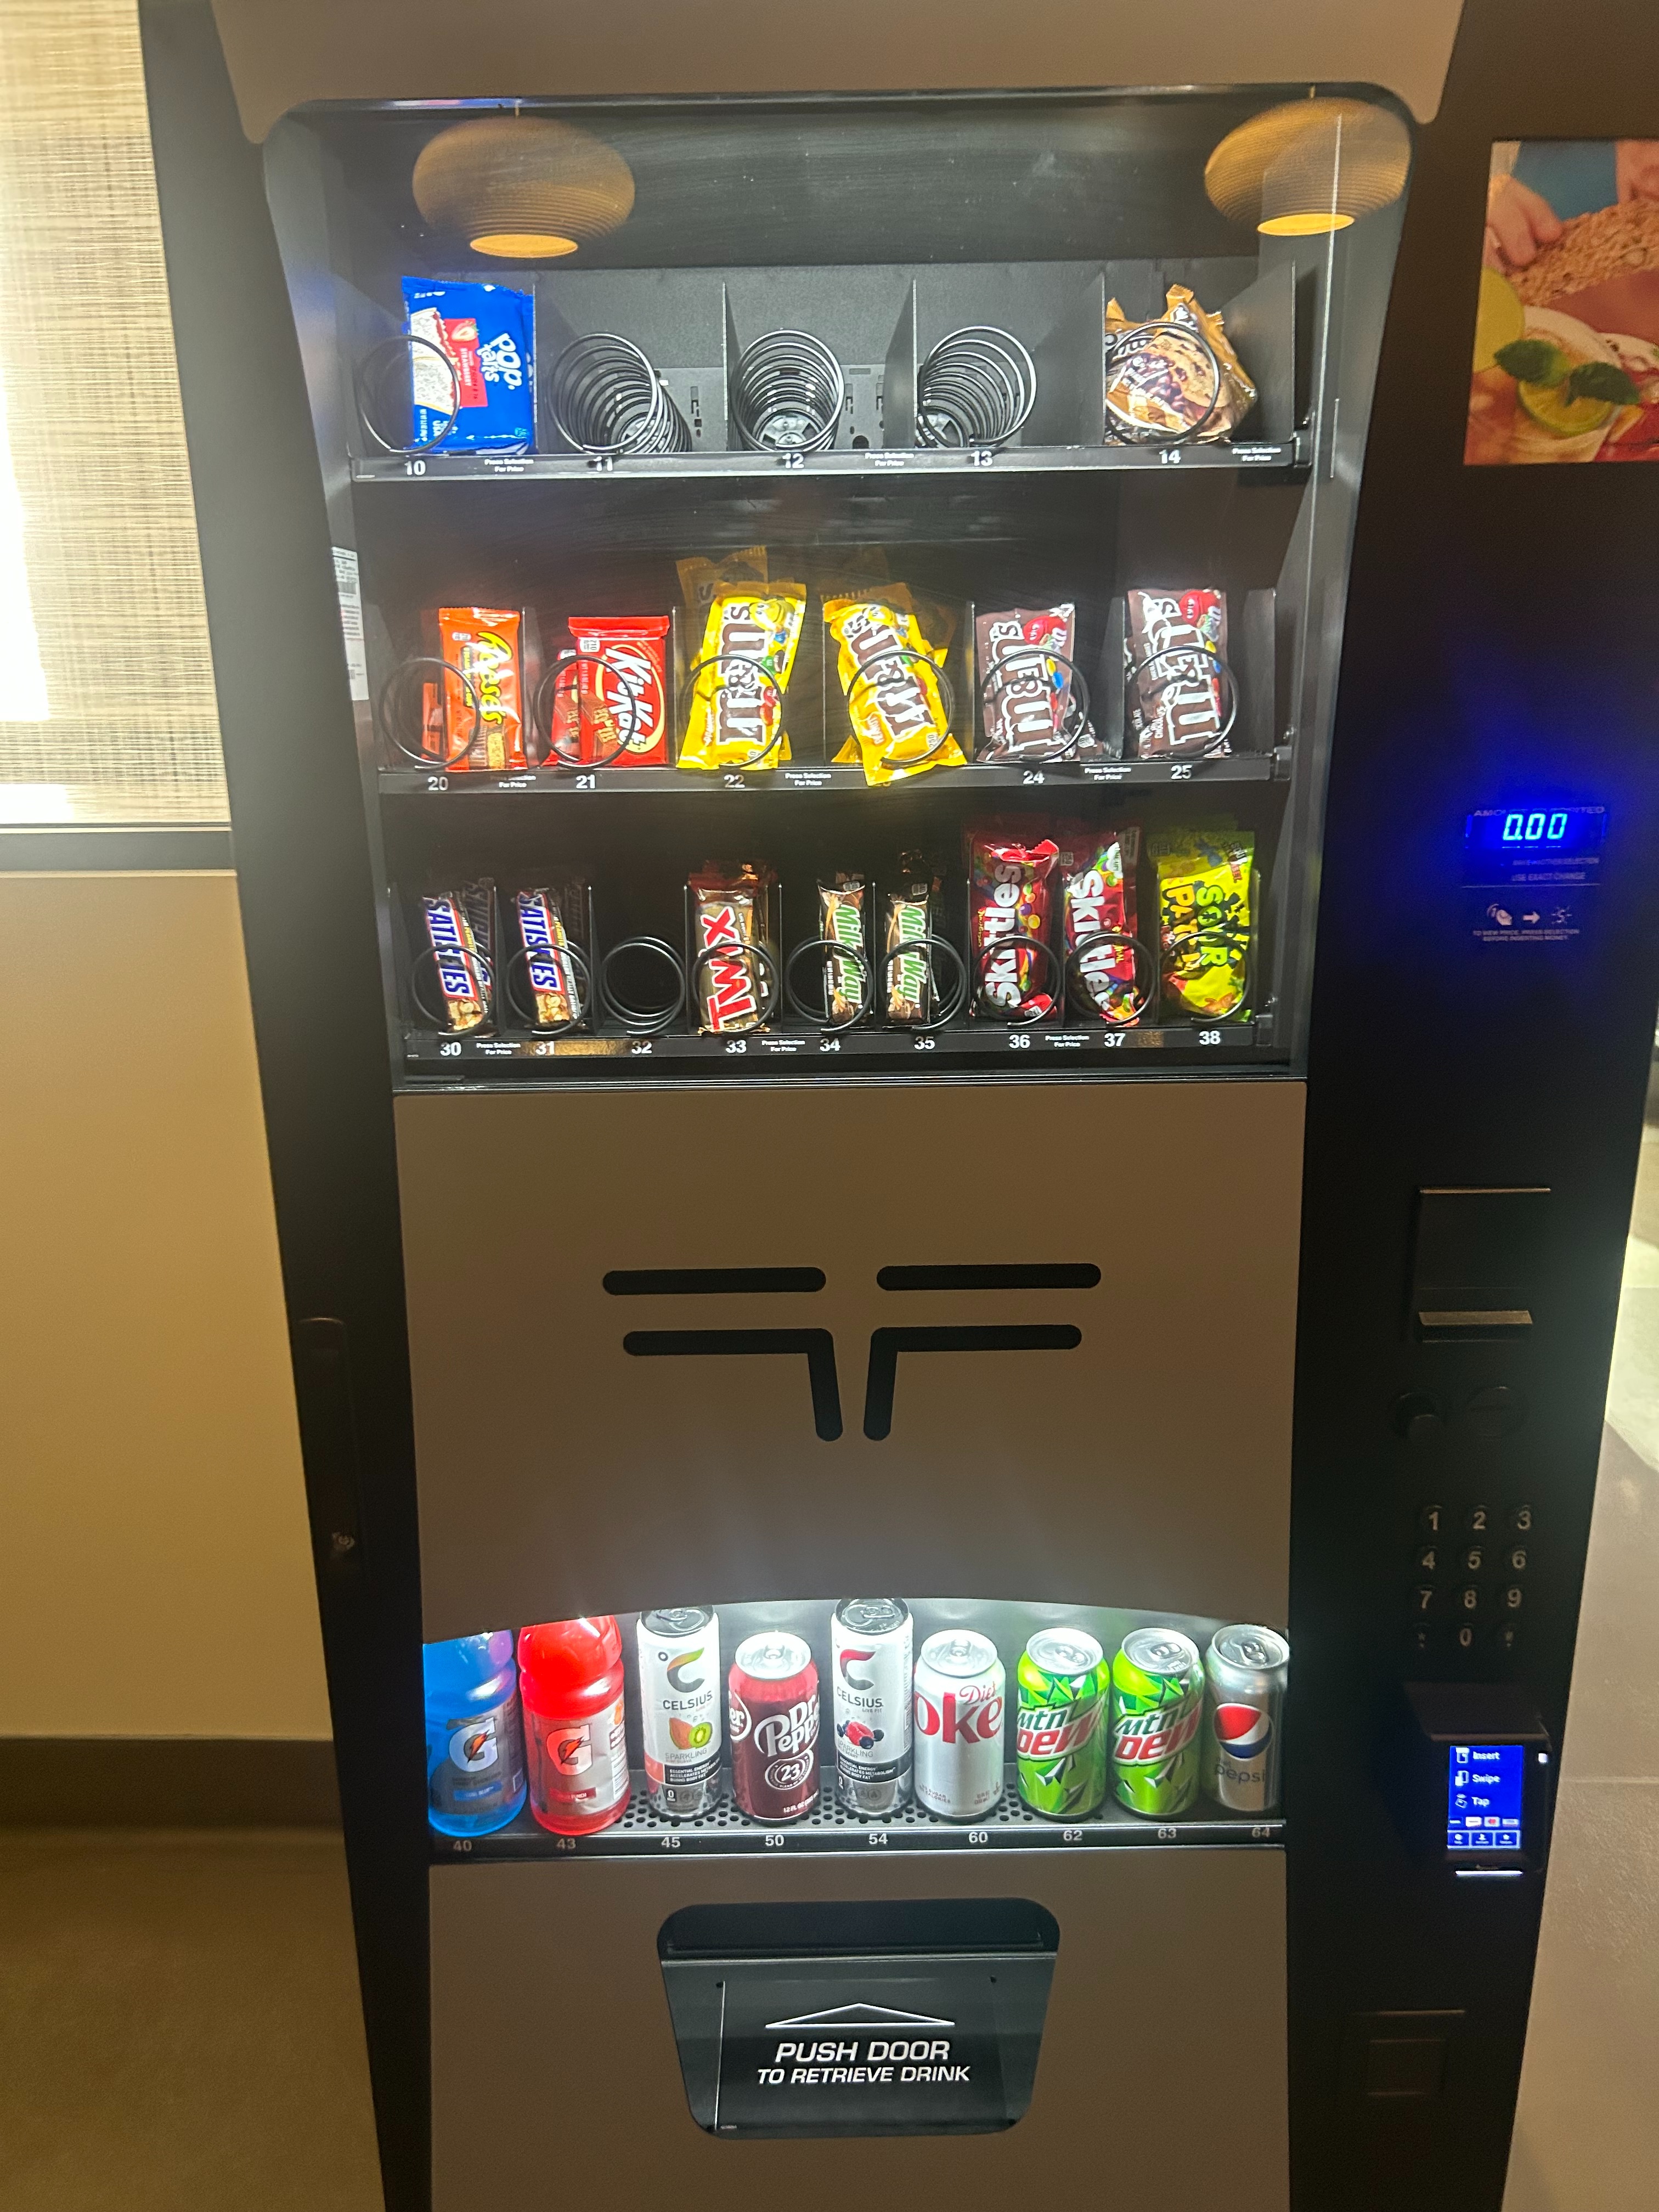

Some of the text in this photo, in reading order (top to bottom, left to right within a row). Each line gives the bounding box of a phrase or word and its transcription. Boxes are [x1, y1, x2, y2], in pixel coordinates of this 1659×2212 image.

[782, 453, 804, 469] 12
[971, 451, 993, 466] 13
[1159, 450, 1181, 464] 14
[405, 460, 426, 476] 10
[1023, 771, 1045, 785] 24
[1171, 765, 1192, 779] 25
[427, 776, 449, 791] 20
[576, 775, 596, 789] 21
[724, 774, 745, 788] 22
[1502, 813, 1568, 840] 0.00
[895, 958, 926, 1001] Way
[820, 1039, 840, 1052] 34
[914, 1036, 935, 1050] 35
[1009, 1035, 1030, 1049] 36
[1104, 1032, 1126, 1048] 37
[1199, 1031, 1221, 1046] 38
[440, 1042, 462, 1056] 30
[535, 1041, 555, 1056] 31
[631, 1041, 652, 1054] 32
[726, 1040, 747, 1053] 33
[1429, 1511, 1439, 1531] 1
[1472, 1510, 1487, 1530] 2
[1517, 1510, 1532, 1530] 3
[1422, 1551, 1436, 1570] 4
[1468, 1550, 1482, 1570] 5
[1512, 1550, 1526, 1570] 6
[1420, 1590, 1432, 1609] 7
[1464, 1589, 1477, 1609] 8
[1508, 1588, 1522, 1608] 9
[1459, 1627, 1472, 1647] 0
[837, 1686, 883, 1708] CELSIUS
[959, 1680, 996, 1705] Diet
[663, 1690, 713, 1711] CELSIUS
[788, 1694, 816, 1732] Dr
[915, 1691, 1003, 1744] oke
[665, 1747, 708, 1760] SPARKLING
[838, 1738, 874, 1757] SPARKLING
[1472, 1751, 1500, 1760] Insert
[780, 1763, 800, 1782] 23
[1214, 1764, 1266, 1784] pepsi
[1472, 1774, 1500, 1785] Swipe
[1471, 1797, 1490, 1807] Tap
[868, 1833, 888, 1844] 54
[968, 1831, 988, 1843] 60
[1063, 1830, 1083, 1842] 62
[1158, 1828, 1177, 1839] 63
[1251, 1827, 1271, 1839] 64
[453, 1839, 472, 1852] 40
[557, 1838, 576, 1850] 43
[661, 1837, 681, 1848] 45
[765, 1835, 785, 1847] 50
[775, 2040, 951, 2063] PUSH DOOR
[757, 2065, 970, 2084] TO RETRIEVE DRINK
